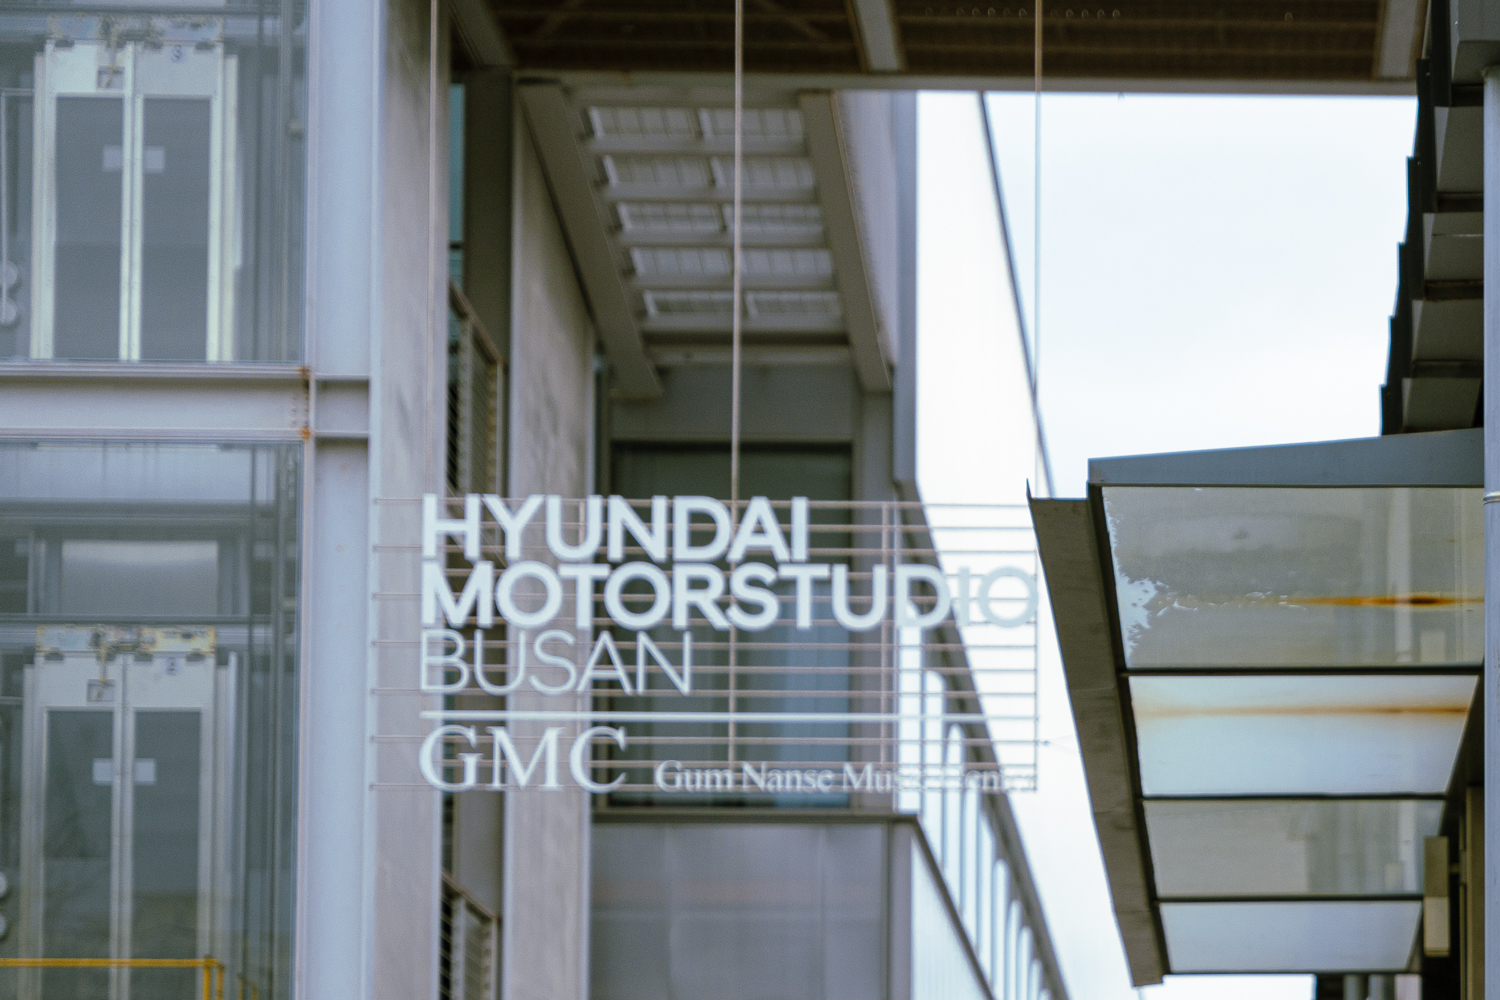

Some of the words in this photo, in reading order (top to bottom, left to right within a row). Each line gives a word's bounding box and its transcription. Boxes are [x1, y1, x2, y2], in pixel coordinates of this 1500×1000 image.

[421, 493, 808, 562] HYUNDAI
[420, 561, 1040, 631] MOTORSTUDIO
[420, 629, 693, 695] BUSAN
[418, 724, 628, 793] GMC
[654, 760, 734, 792] Gum
[741, 761, 834, 793] Nanse
